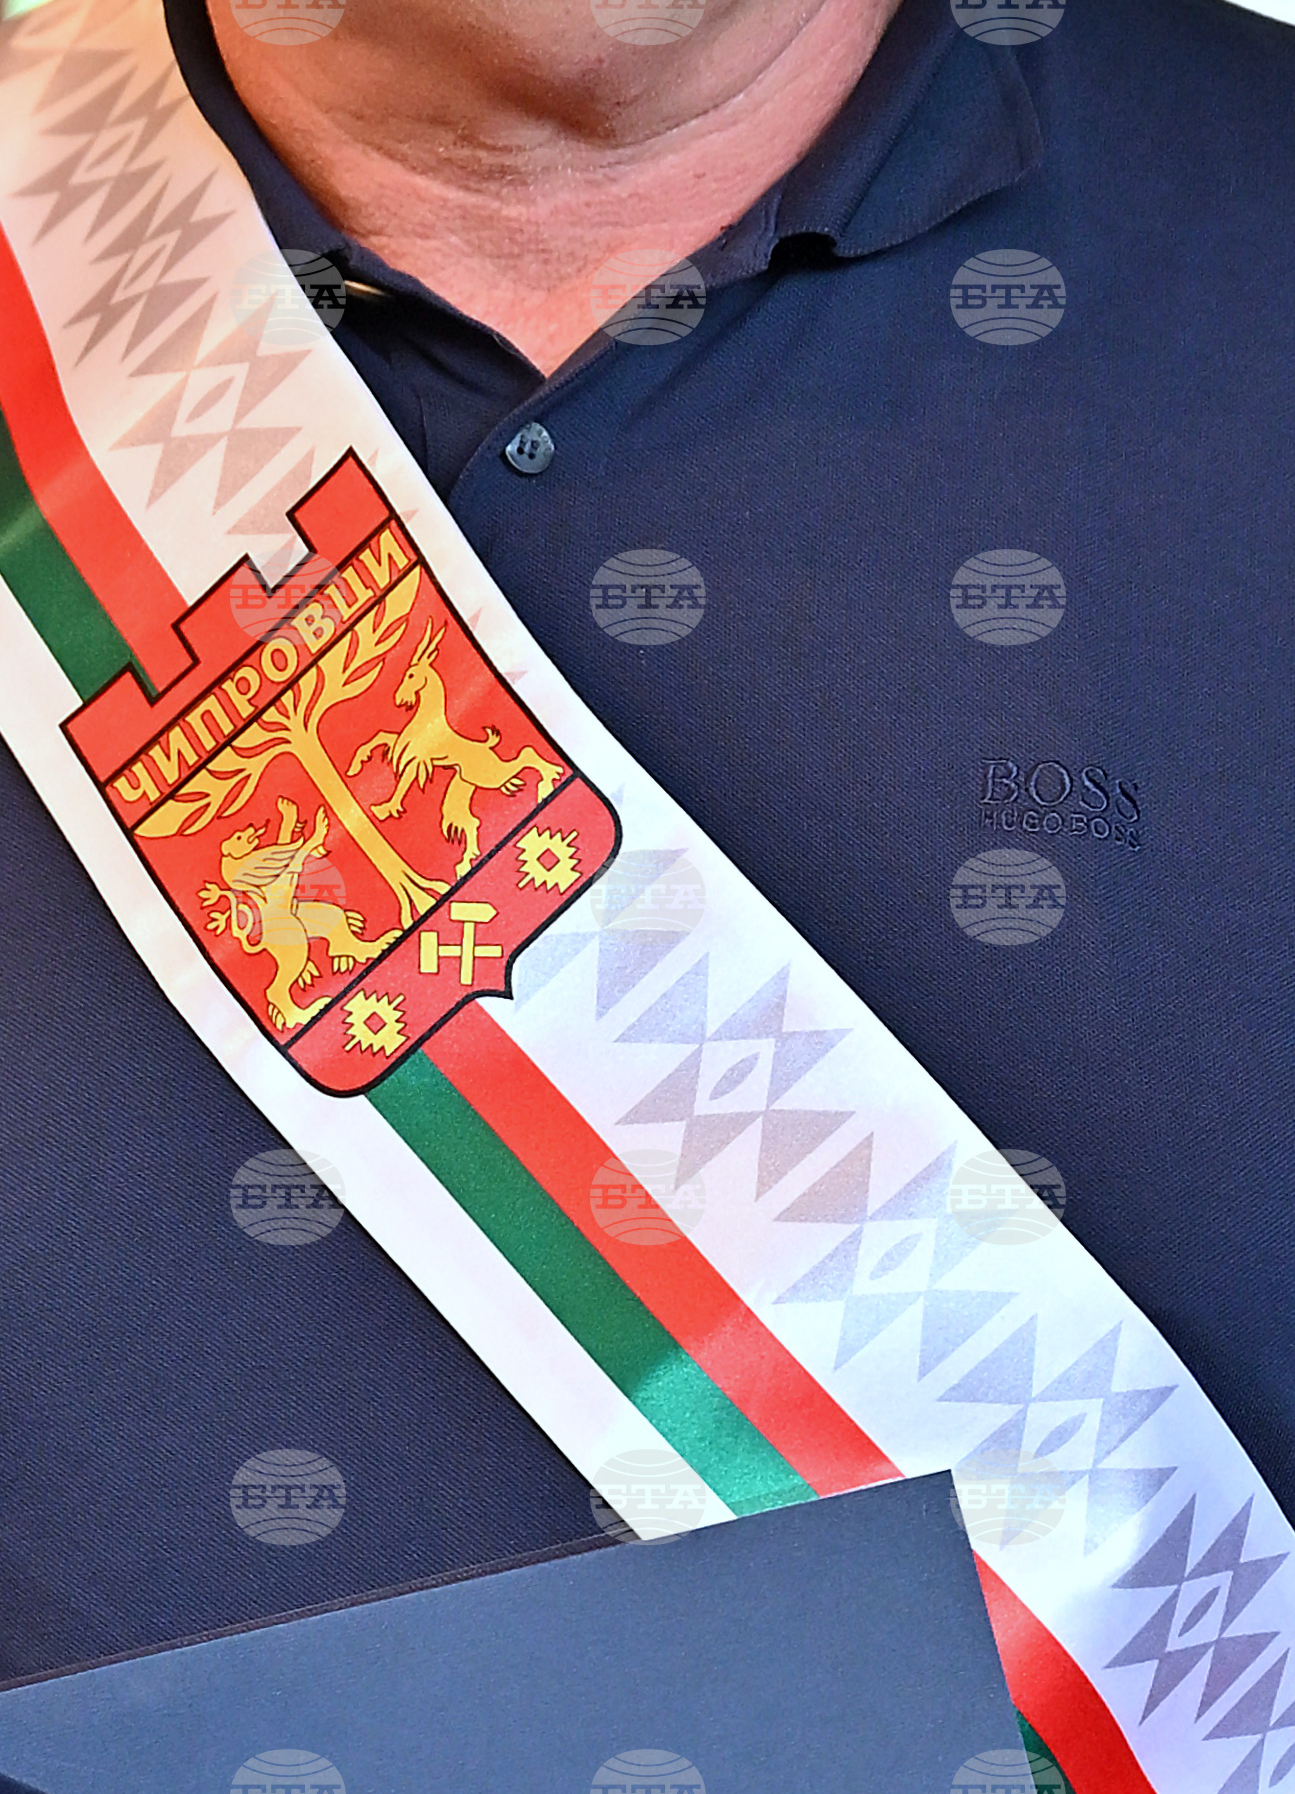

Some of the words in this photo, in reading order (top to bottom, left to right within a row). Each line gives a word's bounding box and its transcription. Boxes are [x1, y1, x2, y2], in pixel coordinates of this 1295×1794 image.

[113, 527, 409, 804] ЧИПРОВЦИ
[979, 759, 1141, 823] BOSS
[979, 809, 1064, 834] HUGO
